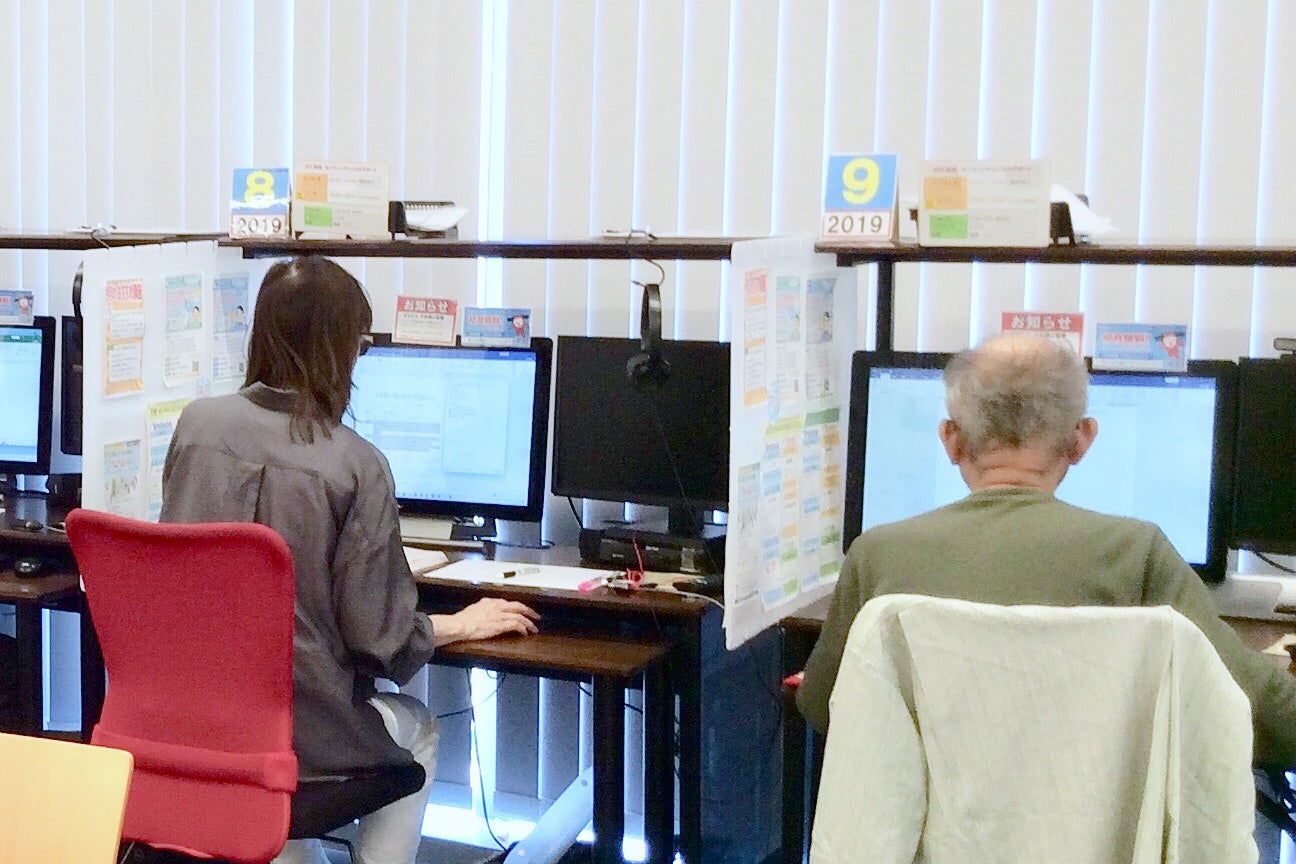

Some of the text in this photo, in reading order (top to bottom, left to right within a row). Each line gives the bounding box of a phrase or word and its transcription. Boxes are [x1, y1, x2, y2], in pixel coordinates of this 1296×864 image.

[244, 169, 275, 208] 8
[841, 157, 880, 205] 9
[237, 217, 282, 233] 2019
[827, 215, 882, 233] 2019
[403, 299, 448, 313] お知らせ
[1011, 314, 1072, 330] お知らせ
